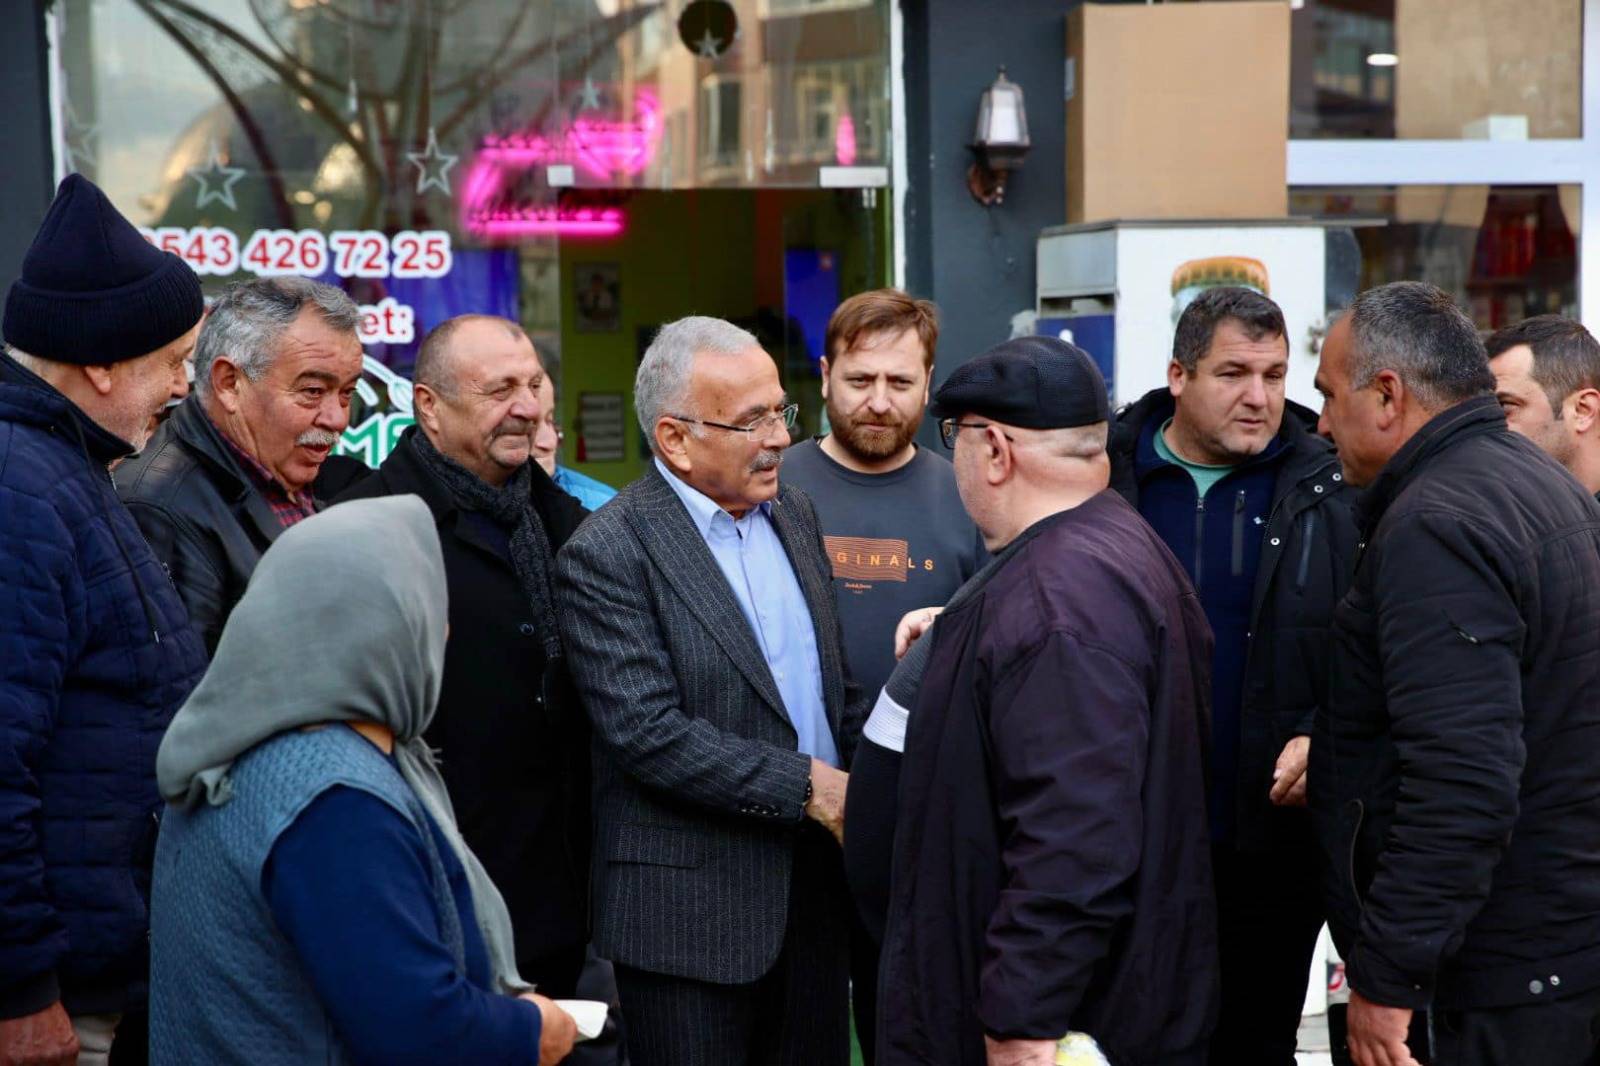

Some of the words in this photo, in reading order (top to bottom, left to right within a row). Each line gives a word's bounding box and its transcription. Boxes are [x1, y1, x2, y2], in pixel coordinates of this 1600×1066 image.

[248, 236, 322, 269] 426
[337, 238, 384, 271] 72
[398, 238, 447, 271] 25
